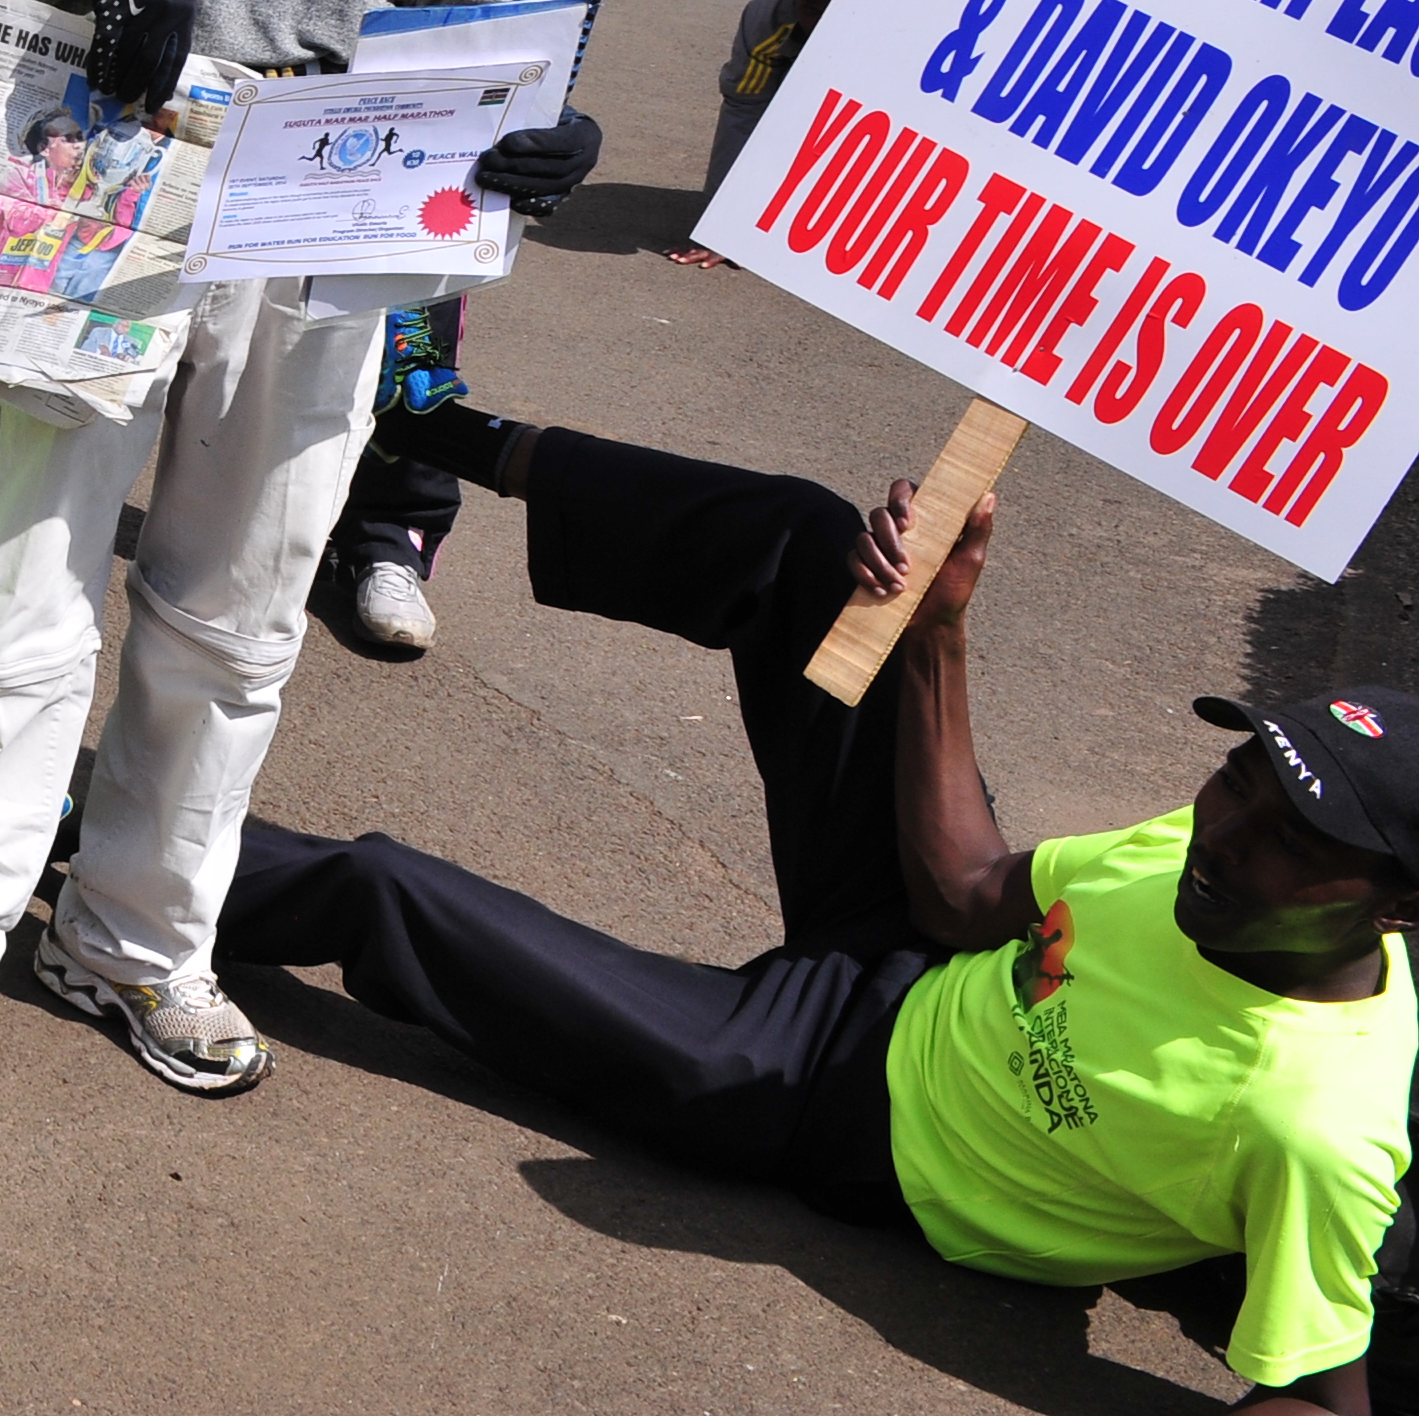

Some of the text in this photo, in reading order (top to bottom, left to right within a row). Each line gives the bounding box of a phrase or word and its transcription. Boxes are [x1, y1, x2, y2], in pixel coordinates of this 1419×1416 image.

[14, 29, 52, 56] HAS
[54, 41, 87, 69] WH
[323, 116, 346, 126] MAR
[372, 113, 398, 122] HALF
[399, 109, 455, 121] MARATHON
[426, 150, 482, 161] PEACE WAL
[318, 234, 361, 242] EDUCATION
[19, 296, 45, 308] Nyayo
[755, 88, 1389, 528] YOUR TIME IS OVER
[1262, 719, 1323, 800] KENYA
